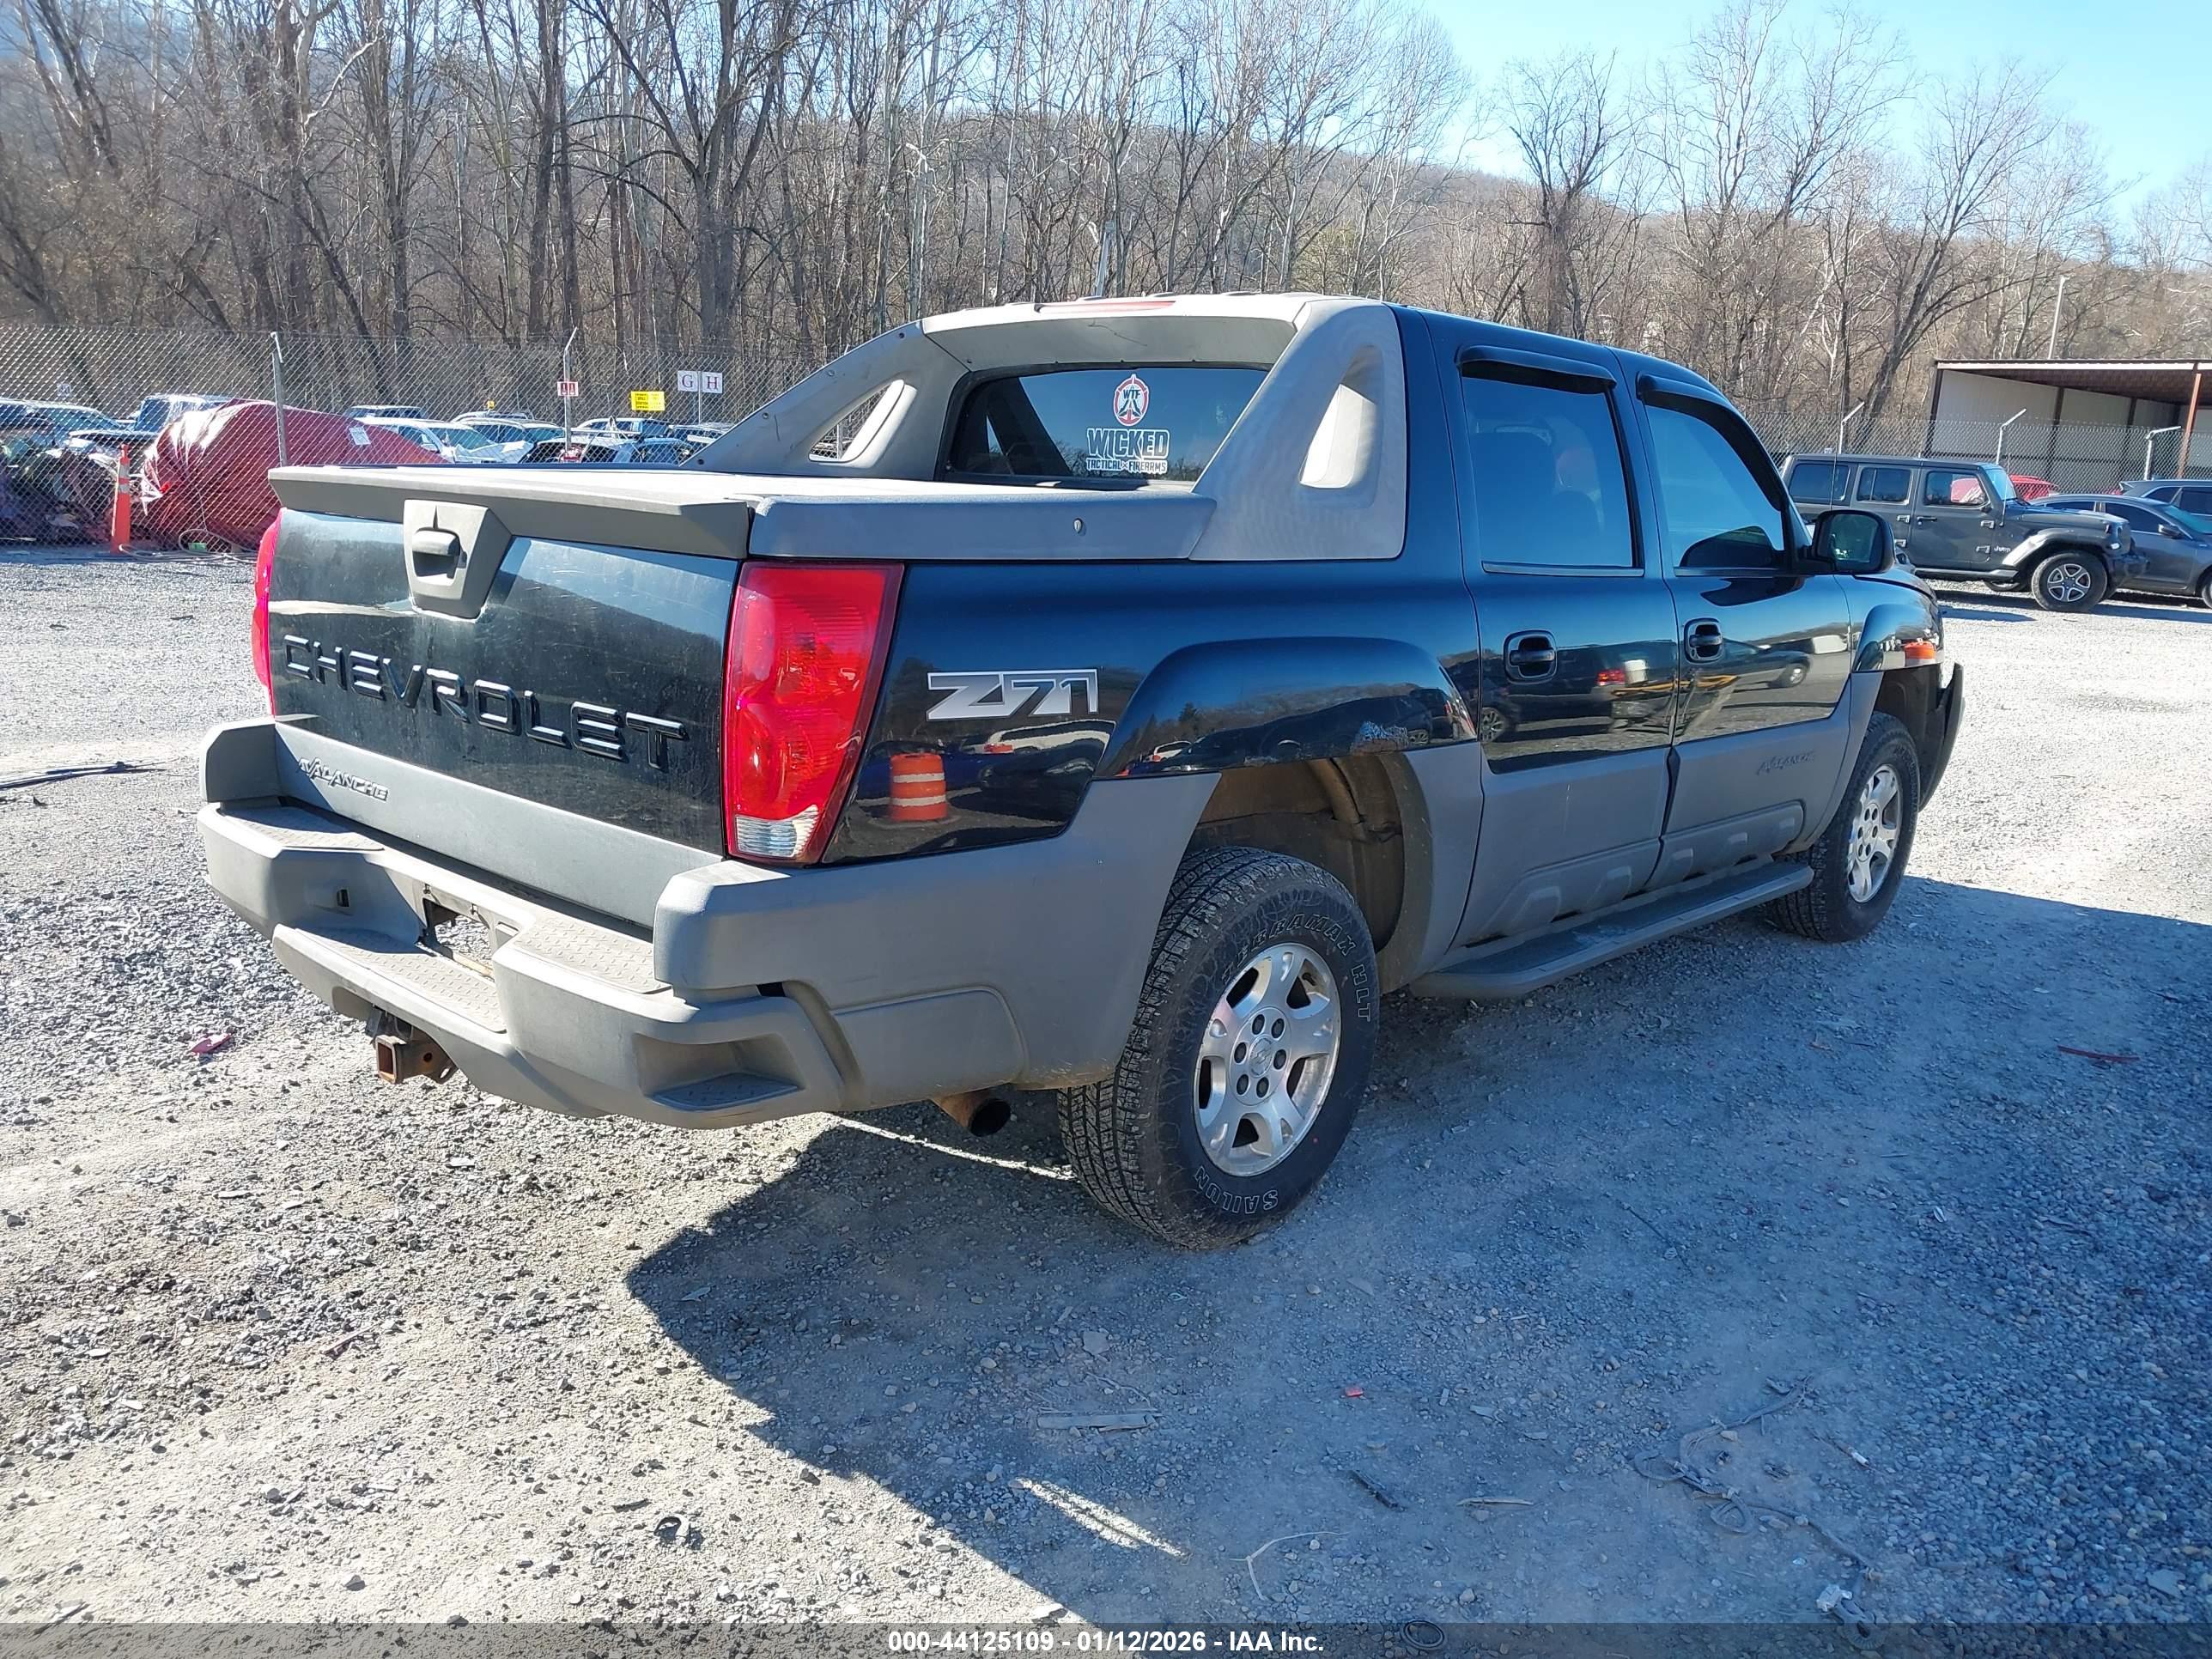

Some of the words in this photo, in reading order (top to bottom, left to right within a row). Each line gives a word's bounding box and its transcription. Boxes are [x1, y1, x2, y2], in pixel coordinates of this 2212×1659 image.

[682, 374, 694, 388] G
[706, 375, 719, 389] H
[1123, 389, 1141, 399] WTF
[1087, 428, 1170, 459] WICKED
[1087, 459, 1121, 471] TACTICAL
[1128, 461, 1167, 472] FIREARMS
[283, 634, 689, 770] CHEVROLET
[927, 669, 1099, 721] Z71
[298, 757, 390, 802] AVALANCHE
[1351, 963, 1372, 1022] HLT
[1194, 1165, 1279, 1214] SAILUN
